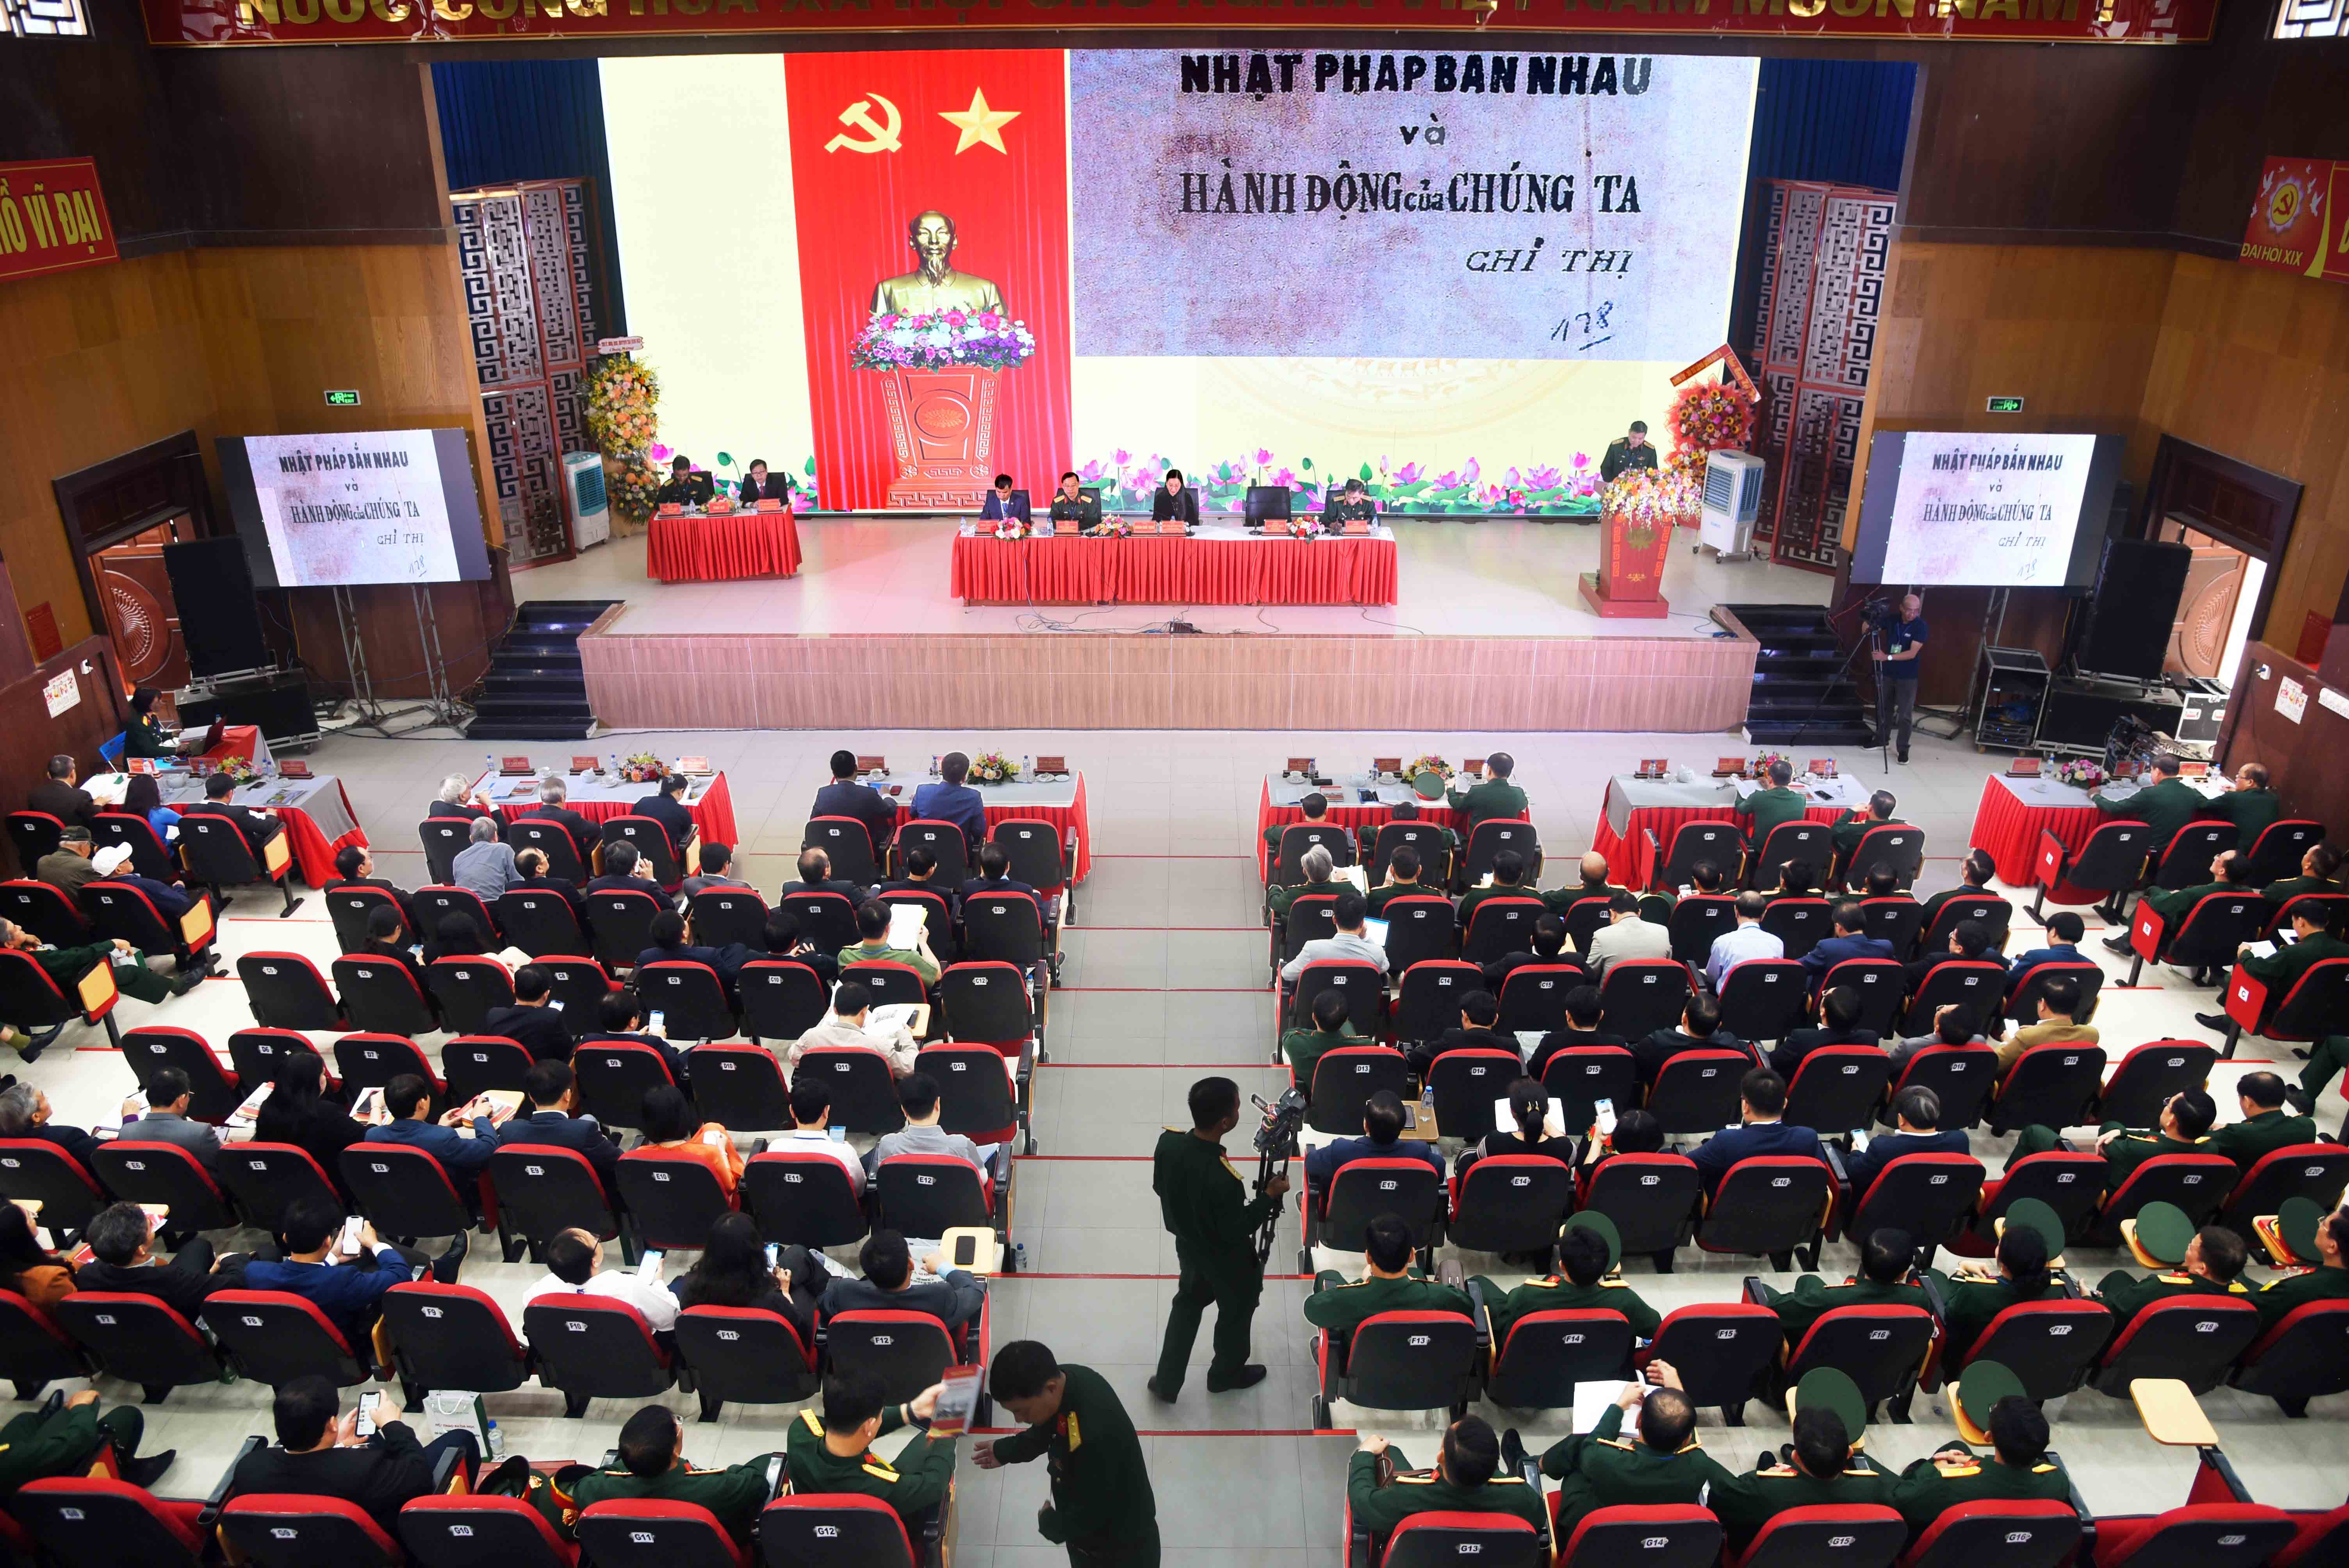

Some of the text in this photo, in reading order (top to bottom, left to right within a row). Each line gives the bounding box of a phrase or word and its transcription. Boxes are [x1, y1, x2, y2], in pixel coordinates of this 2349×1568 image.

[1526, 55, 1652, 95] NHAU
[1399, 113, 1447, 146] và
[1179, 159, 1641, 221] HÀNH ĐỘNG của CHÚNG TA
[22, 182, 59, 249] VĨ
[53, 190, 103, 254] ĐẠI
[1466, 237, 1634, 280] CHỈ THỊ
[2241, 242, 2262, 260] ĐẠI
[2283, 249, 2304, 266] XIX
[278, 450, 312, 476] NHẬT
[315, 447, 346, 471] PHÁP
[373, 451, 409, 468] NHAU
[1932, 448, 1968, 474] NHẬT
[2026, 454, 2063, 471] NHAU
[345, 478, 359, 492] và
[1989, 479, 2002, 492] và
[291, 497, 420, 525] HÀNH ĐỘNG của CHÚNG TA
[1923, 497, 1956, 522] HÀNH
[1957, 499, 1987, 525] ĐỘNG
[1997, 499, 2034, 521] CHÚNG
[2039, 504, 2051, 521] TA
[377, 529, 424, 546] CHỈ THỊ
[1998, 531, 2046, 549] CHỈ THỊ
